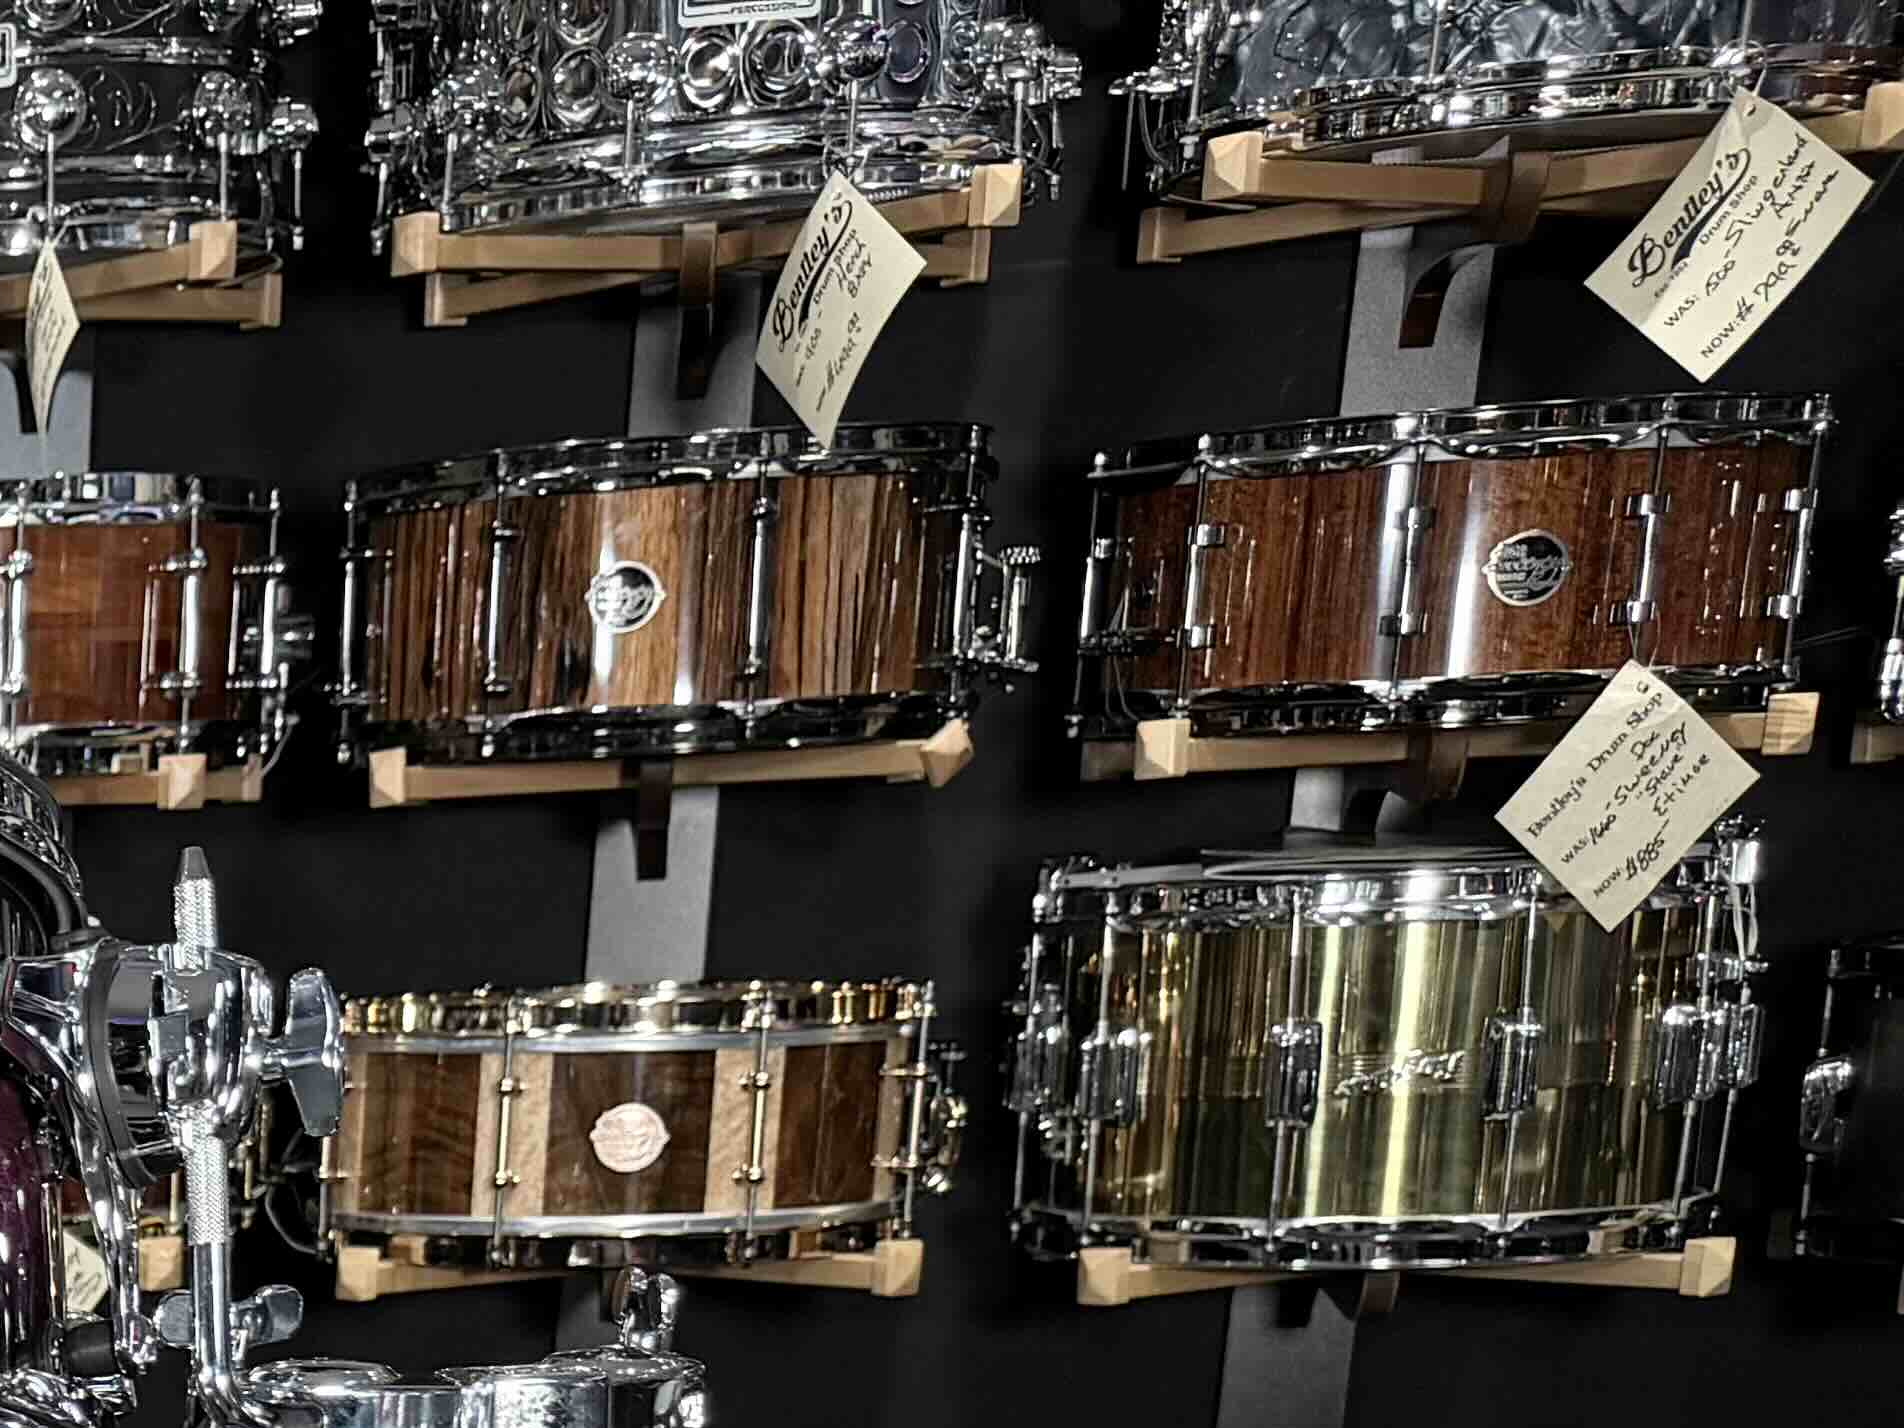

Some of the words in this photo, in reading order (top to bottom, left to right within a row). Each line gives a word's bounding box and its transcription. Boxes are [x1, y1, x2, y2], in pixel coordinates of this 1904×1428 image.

[772, 199, 852, 352] Bentley's
[1627, 150, 1747, 289] Bentley's
[1698, 210, 1732, 245] Drum
[1733, 174, 1760, 210] Shop
[1526, 776, 1588, 838] Bentley's
[1587, 732, 1629, 774] Drum
[1626, 692, 1664, 730] Shop
